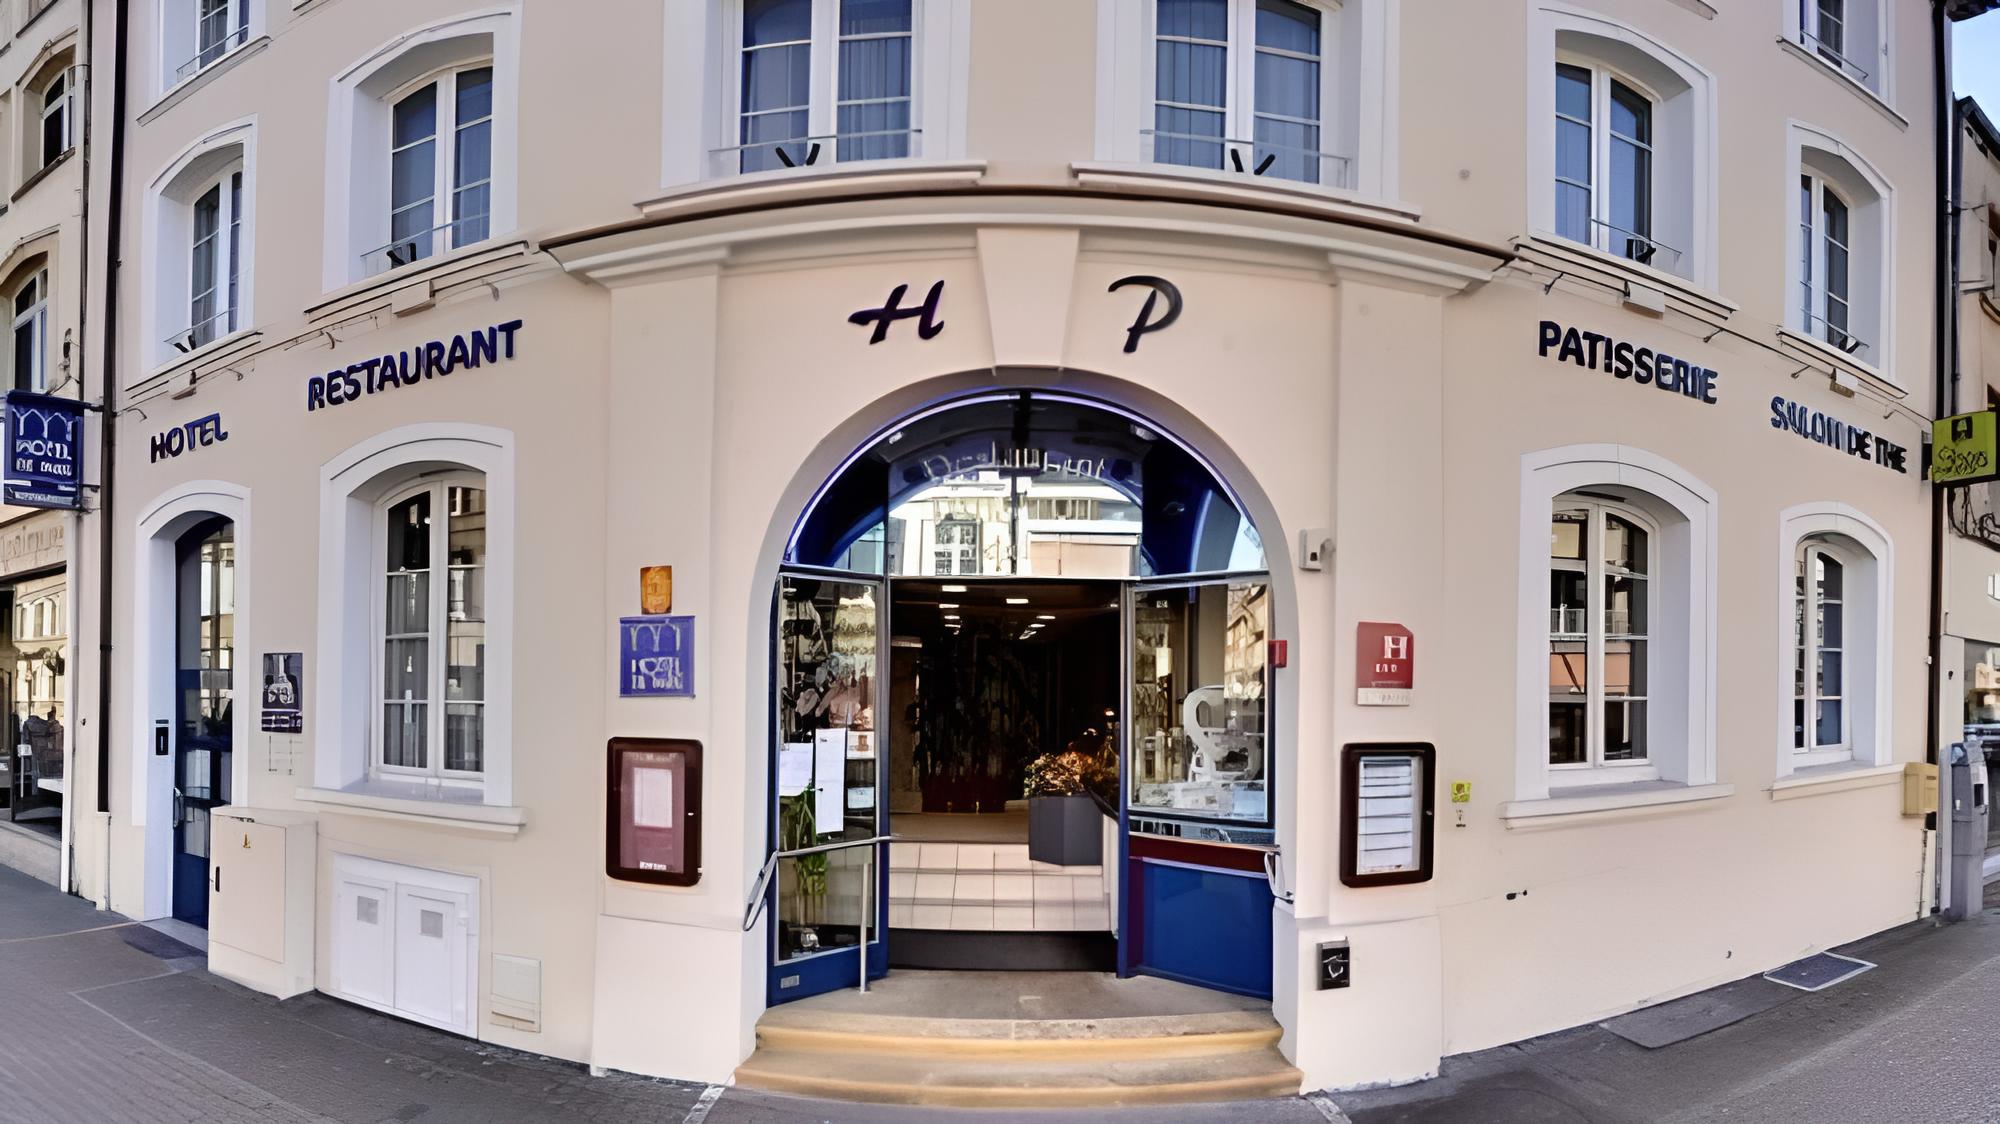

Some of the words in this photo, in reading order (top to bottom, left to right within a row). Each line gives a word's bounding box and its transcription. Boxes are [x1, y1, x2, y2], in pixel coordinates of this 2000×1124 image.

[848, 280, 945, 345] H
[1108, 275, 1183, 354] P
[307, 318, 524, 411] RESTAURANT
[1538, 320, 1719, 405] PATISSERIE
[150, 412, 229, 464] HOTEL
[1383, 635, 1408, 660] H
